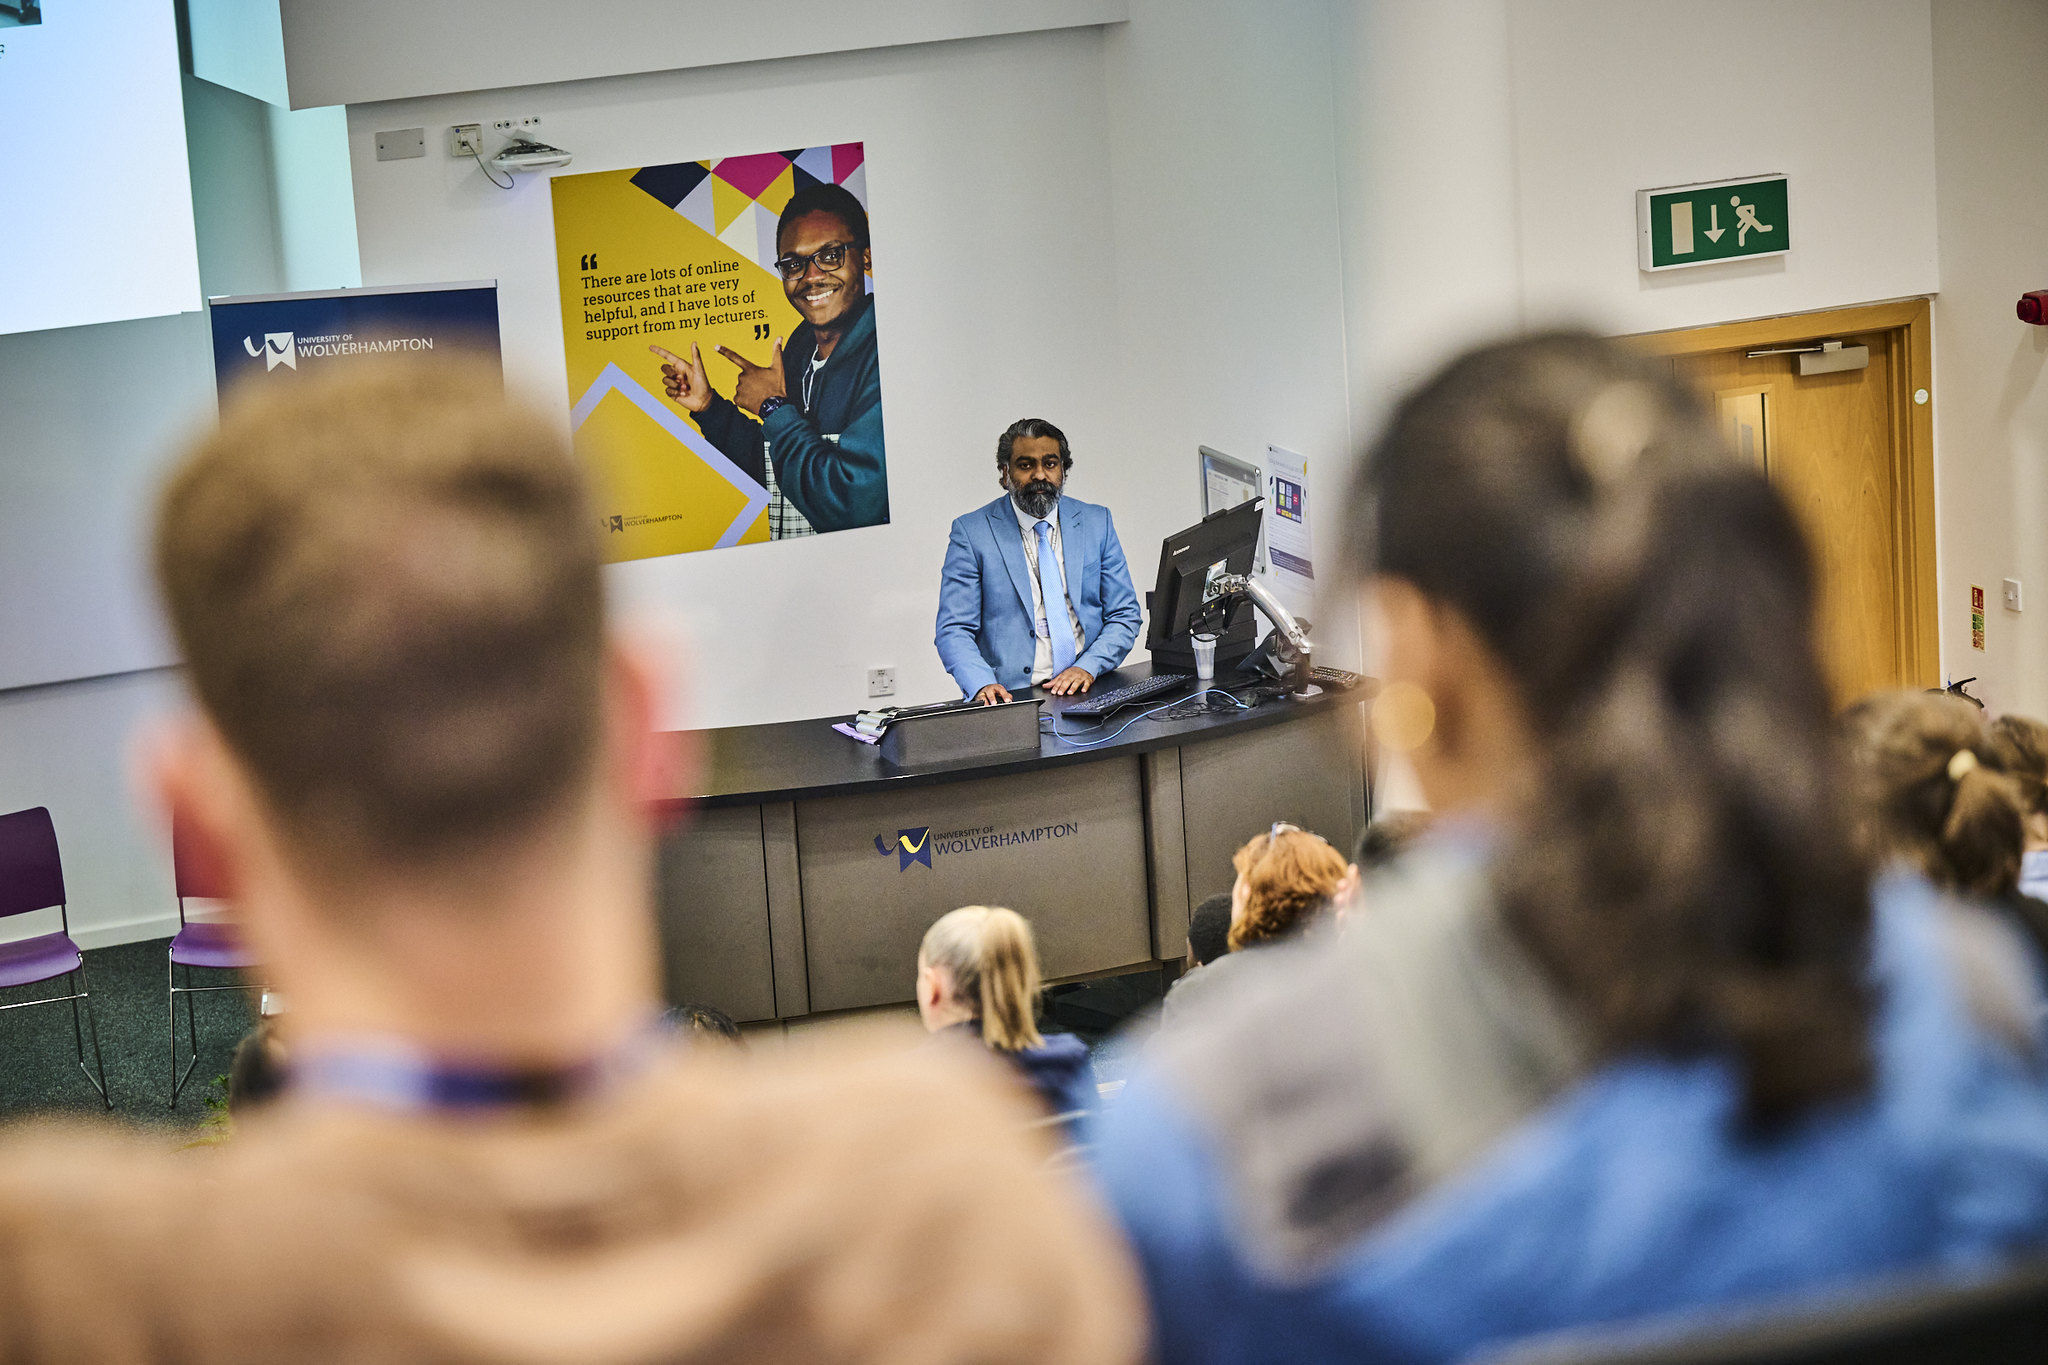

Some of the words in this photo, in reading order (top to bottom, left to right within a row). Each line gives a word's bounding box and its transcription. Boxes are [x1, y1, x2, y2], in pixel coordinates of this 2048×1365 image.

[581, 275, 622, 289] There
[626, 272, 647, 284] are
[650, 267, 676, 282] lots
[679, 263, 695, 277] of
[696, 260, 740, 276] online
[583, 288, 651, 306] resources
[654, 283, 681, 298] that
[685, 281, 706, 294] are
[710, 277, 740, 292] very
[584, 306, 637, 323] helpful,
[640, 301, 666, 316] and
[669, 301, 675, 313] I
[678, 298, 711, 312] have
[714, 293, 739, 308] lots
[742, 290, 756, 304] of
[586, 322, 640, 341] support
[643, 319, 676, 334] from
[679, 316, 701, 331] my
[704, 308, 769, 326] lecturers.
[297, 335, 341, 345] UNIVERSITY
[298, 337, 434, 358] WOLVERHAMPTON
[624, 514, 683, 527] WOLVERHAMPTON
[933, 828, 981, 841] UNIVERSITY
[982, 825, 995, 834] OF
[935, 822, 1079, 856] WOLVERHAMPTON
